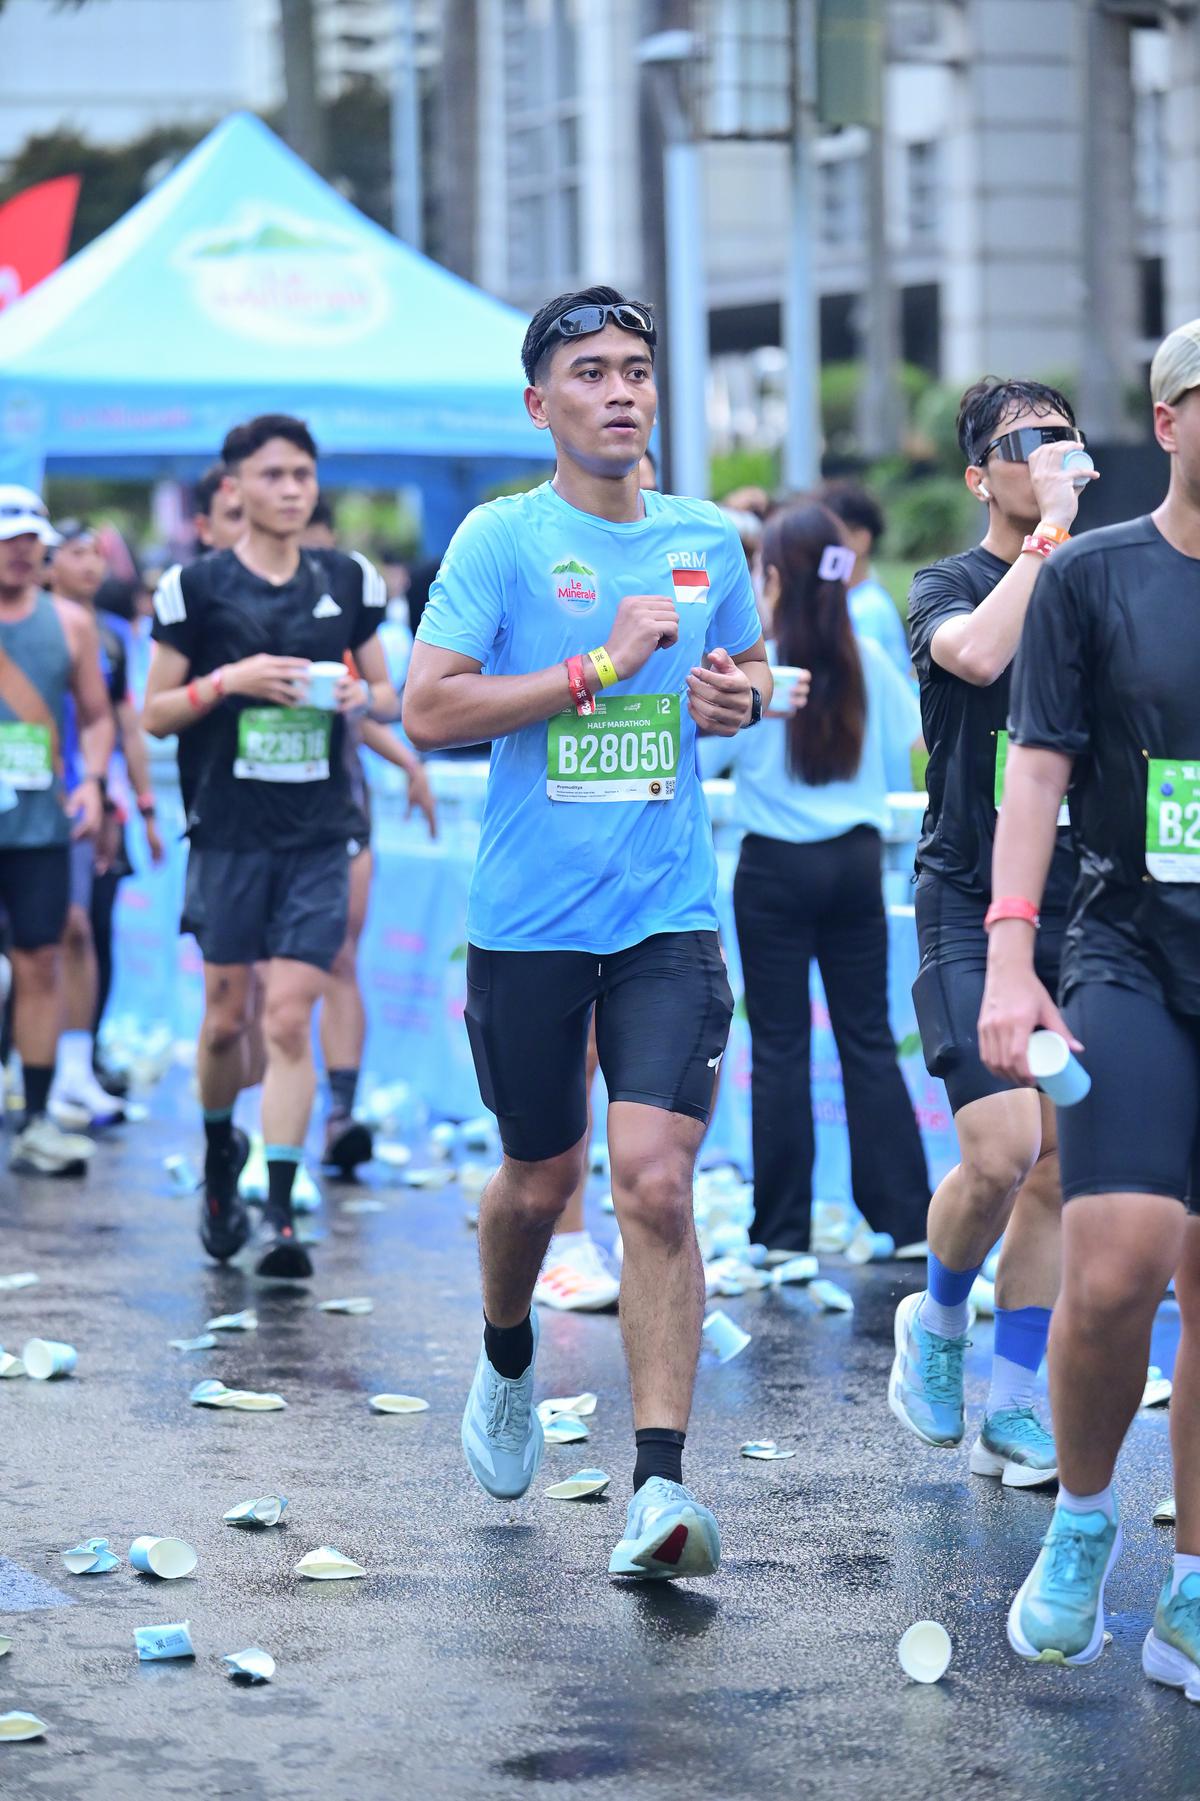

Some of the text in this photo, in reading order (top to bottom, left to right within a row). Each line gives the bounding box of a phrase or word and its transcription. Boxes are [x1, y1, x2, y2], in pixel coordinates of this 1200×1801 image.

[667, 552, 706, 568] PRM
[571, 579, 582, 590] Le
[661, 698, 671, 714] 2
[607, 720, 651, 729] MARATHON
[558, 731, 674, 774] B28050
